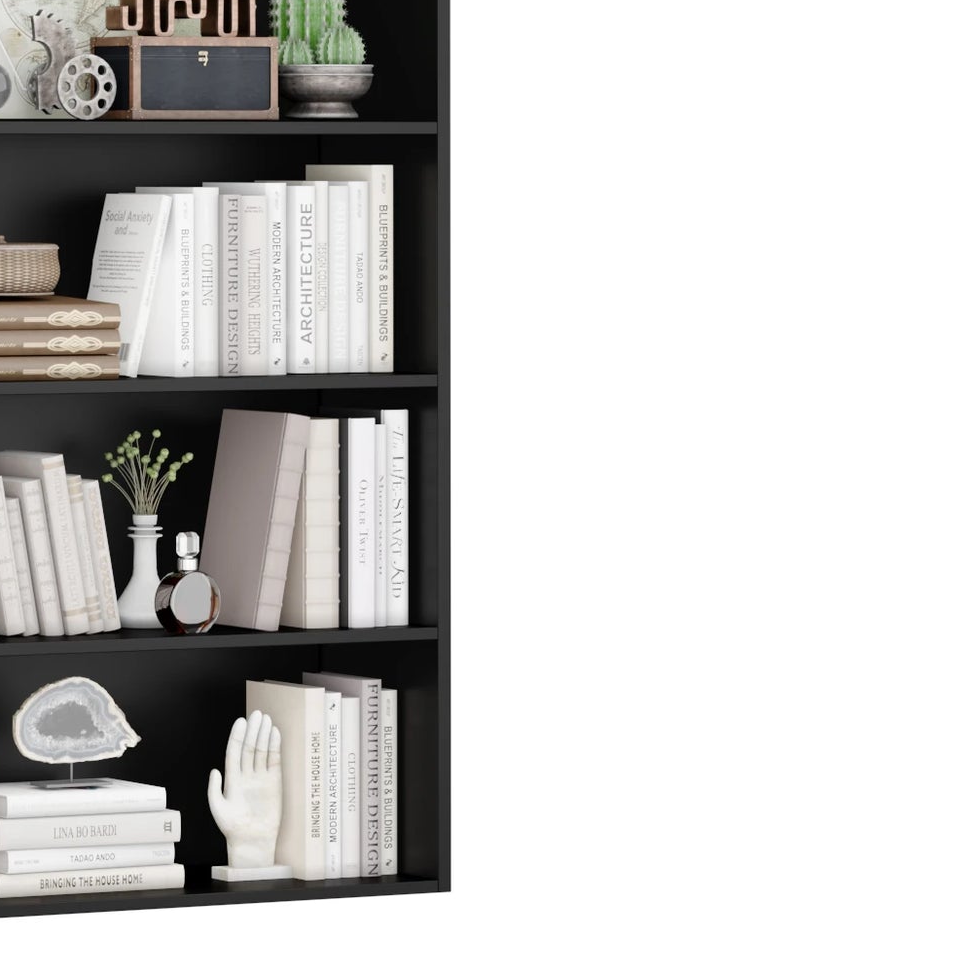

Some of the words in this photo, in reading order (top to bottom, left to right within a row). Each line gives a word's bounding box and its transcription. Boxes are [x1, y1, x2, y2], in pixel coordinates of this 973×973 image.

[105, 209, 126, 222] Social
[379, 204, 388, 271] BLUEPRINTS
[181, 229, 190, 288] BLUEPRINTS
[228, 198, 238, 303] FURNITURE
[272, 222, 281, 264] MODERN
[202, 243, 213, 307] CLOTHING
[248, 248, 261, 308] WUTHERING
[300, 203, 312, 344] ARCHITECTURE
[379, 274, 388, 282] &
[181, 300, 190, 351] BUILDINGS
[272, 267, 281, 344] ARCHITECTURE
[379, 285, 388, 342] BUILDINGS
[228, 309, 238, 374] DESIGN
[248, 313, 261, 356] HEIGHTS
[311, 731, 320, 753] HOME
[329, 724, 338, 798] ARCHITECTURE
[367, 684, 378, 797] FURNITURE
[384, 726, 392, 785] BLUEPRINTS
[311, 755, 320, 781] HOUSE
[311, 783, 320, 798] THE
[348, 752, 356, 812] CLOTHING
[53, 826, 74, 840] LINA
[76, 825, 89, 838] BO
[90, 824, 117, 838] BARDI
[311, 800, 320, 838] BRINGING
[329, 800, 338, 843] MODERN
[367, 804, 378, 876] DESIGN
[384, 797, 392, 849] BUILDINGS
[40, 876, 77, 890] BRINGING
[79, 875, 93, 887] THE
[95, 874, 120, 886] HOUSE
[122, 873, 143, 884] HOME
[70, 853, 94, 863] TADAO
[95, 852, 116, 861] ANDO
